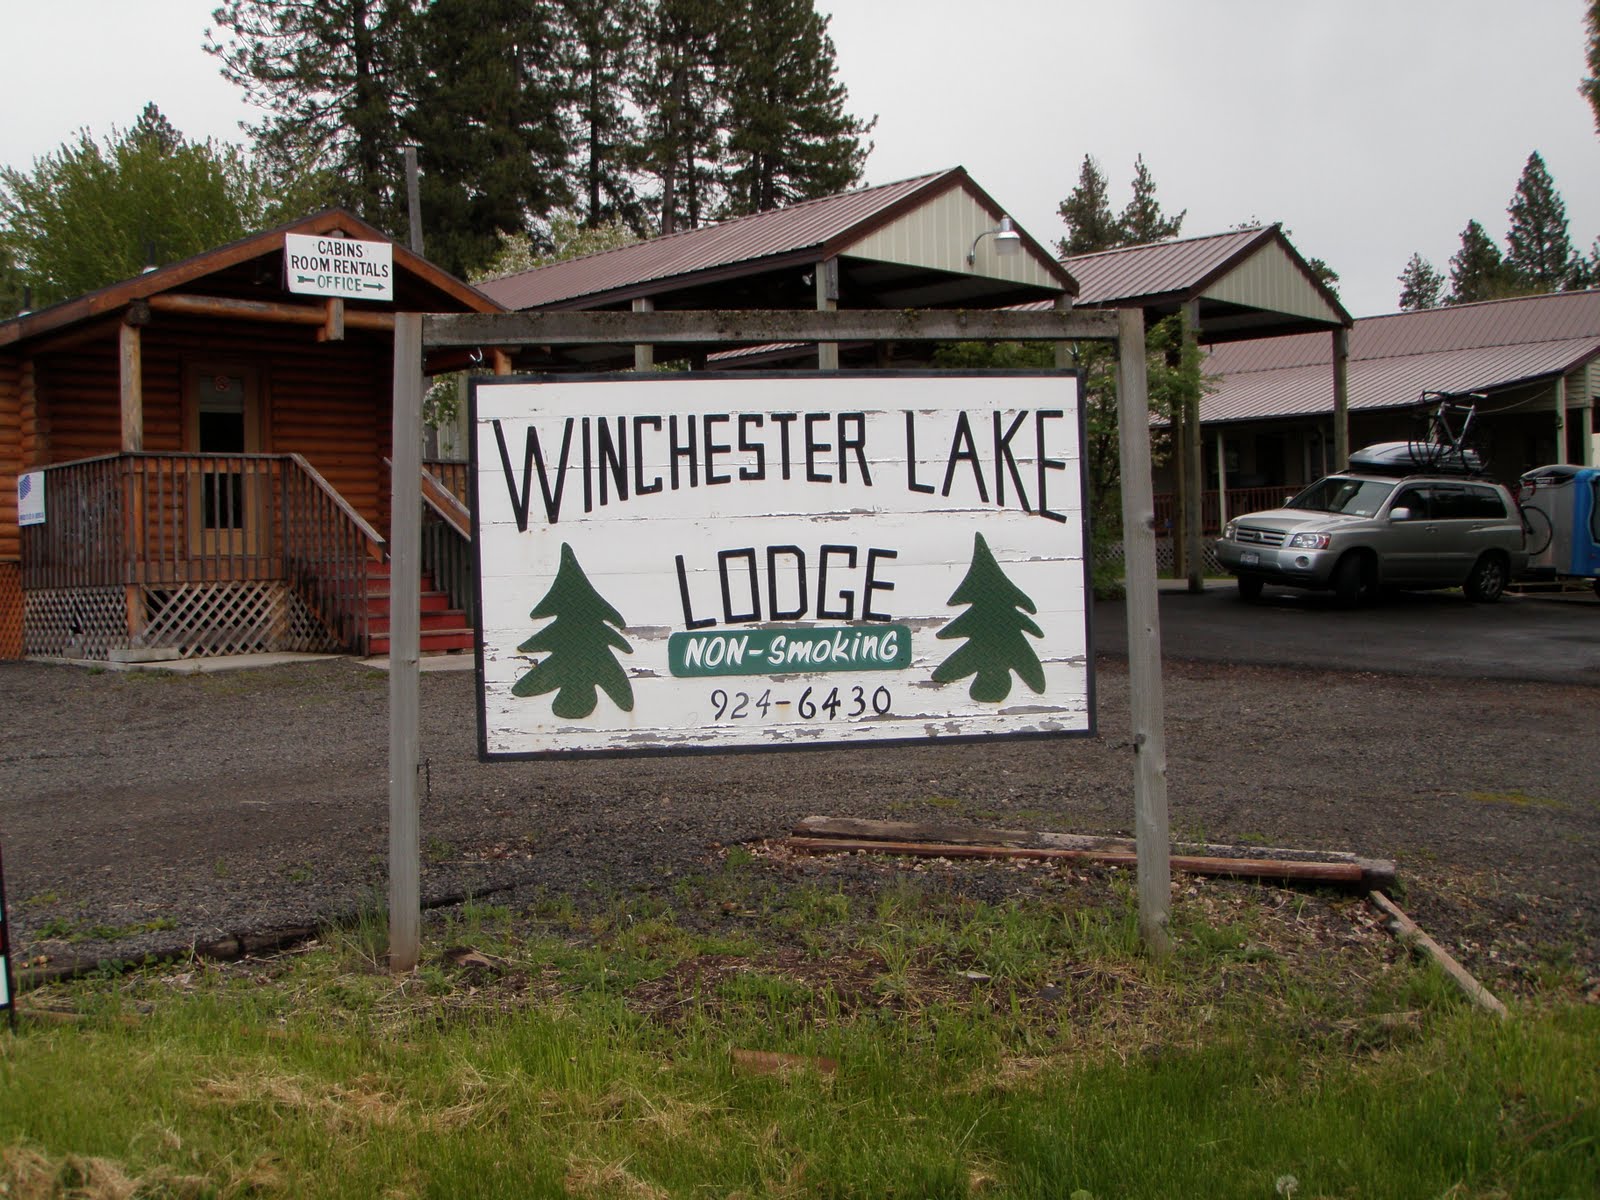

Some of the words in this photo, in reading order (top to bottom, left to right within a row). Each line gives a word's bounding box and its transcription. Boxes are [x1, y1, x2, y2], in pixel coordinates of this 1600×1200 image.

[318, 240, 363, 258] CABINS
[291, 255, 330, 272] ROOM
[334, 259, 389, 278] RENTALS
[317, 275, 362, 292] OFFICE
[493, 411, 873, 532] WINCHESTER
[905, 409, 1068, 524] LAKE
[675, 544, 898, 631] LODGE
[710, 685, 892, 721] 924-6430
